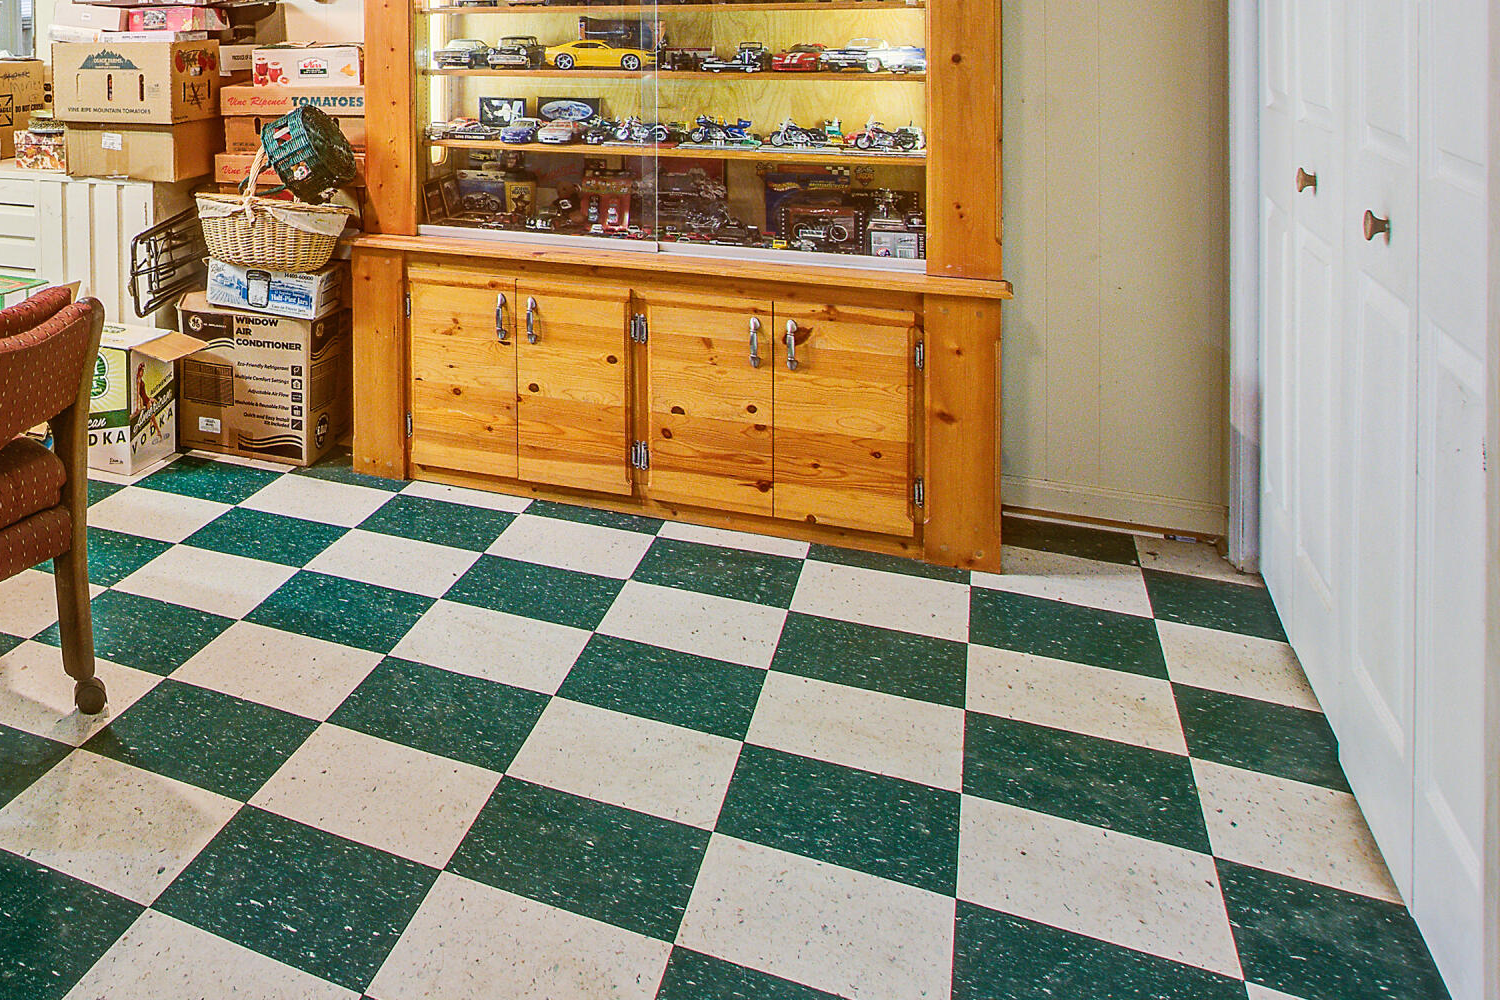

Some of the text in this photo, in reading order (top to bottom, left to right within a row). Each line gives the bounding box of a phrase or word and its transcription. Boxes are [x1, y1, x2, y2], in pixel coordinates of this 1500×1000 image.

[228, 96, 364, 107] Vine Ripened TOMATOES
[222, 166, 240, 175] Vine
[235, 316, 278, 327] WINDOW
[235, 327, 252, 336] AIR
[235, 338, 302, 351] CONDITIONER
[237, 361, 289, 372] Eco-Friendly Refrigerant
[235, 373, 289, 385] Multiple Comfort Settings
[248, 388, 270, 396] Adjustable
[279, 403, 289, 411] Filter
[265, 413, 274, 421] Easy
[132, 407, 173, 455] VODKA
[89, 430, 126, 446] DKA
